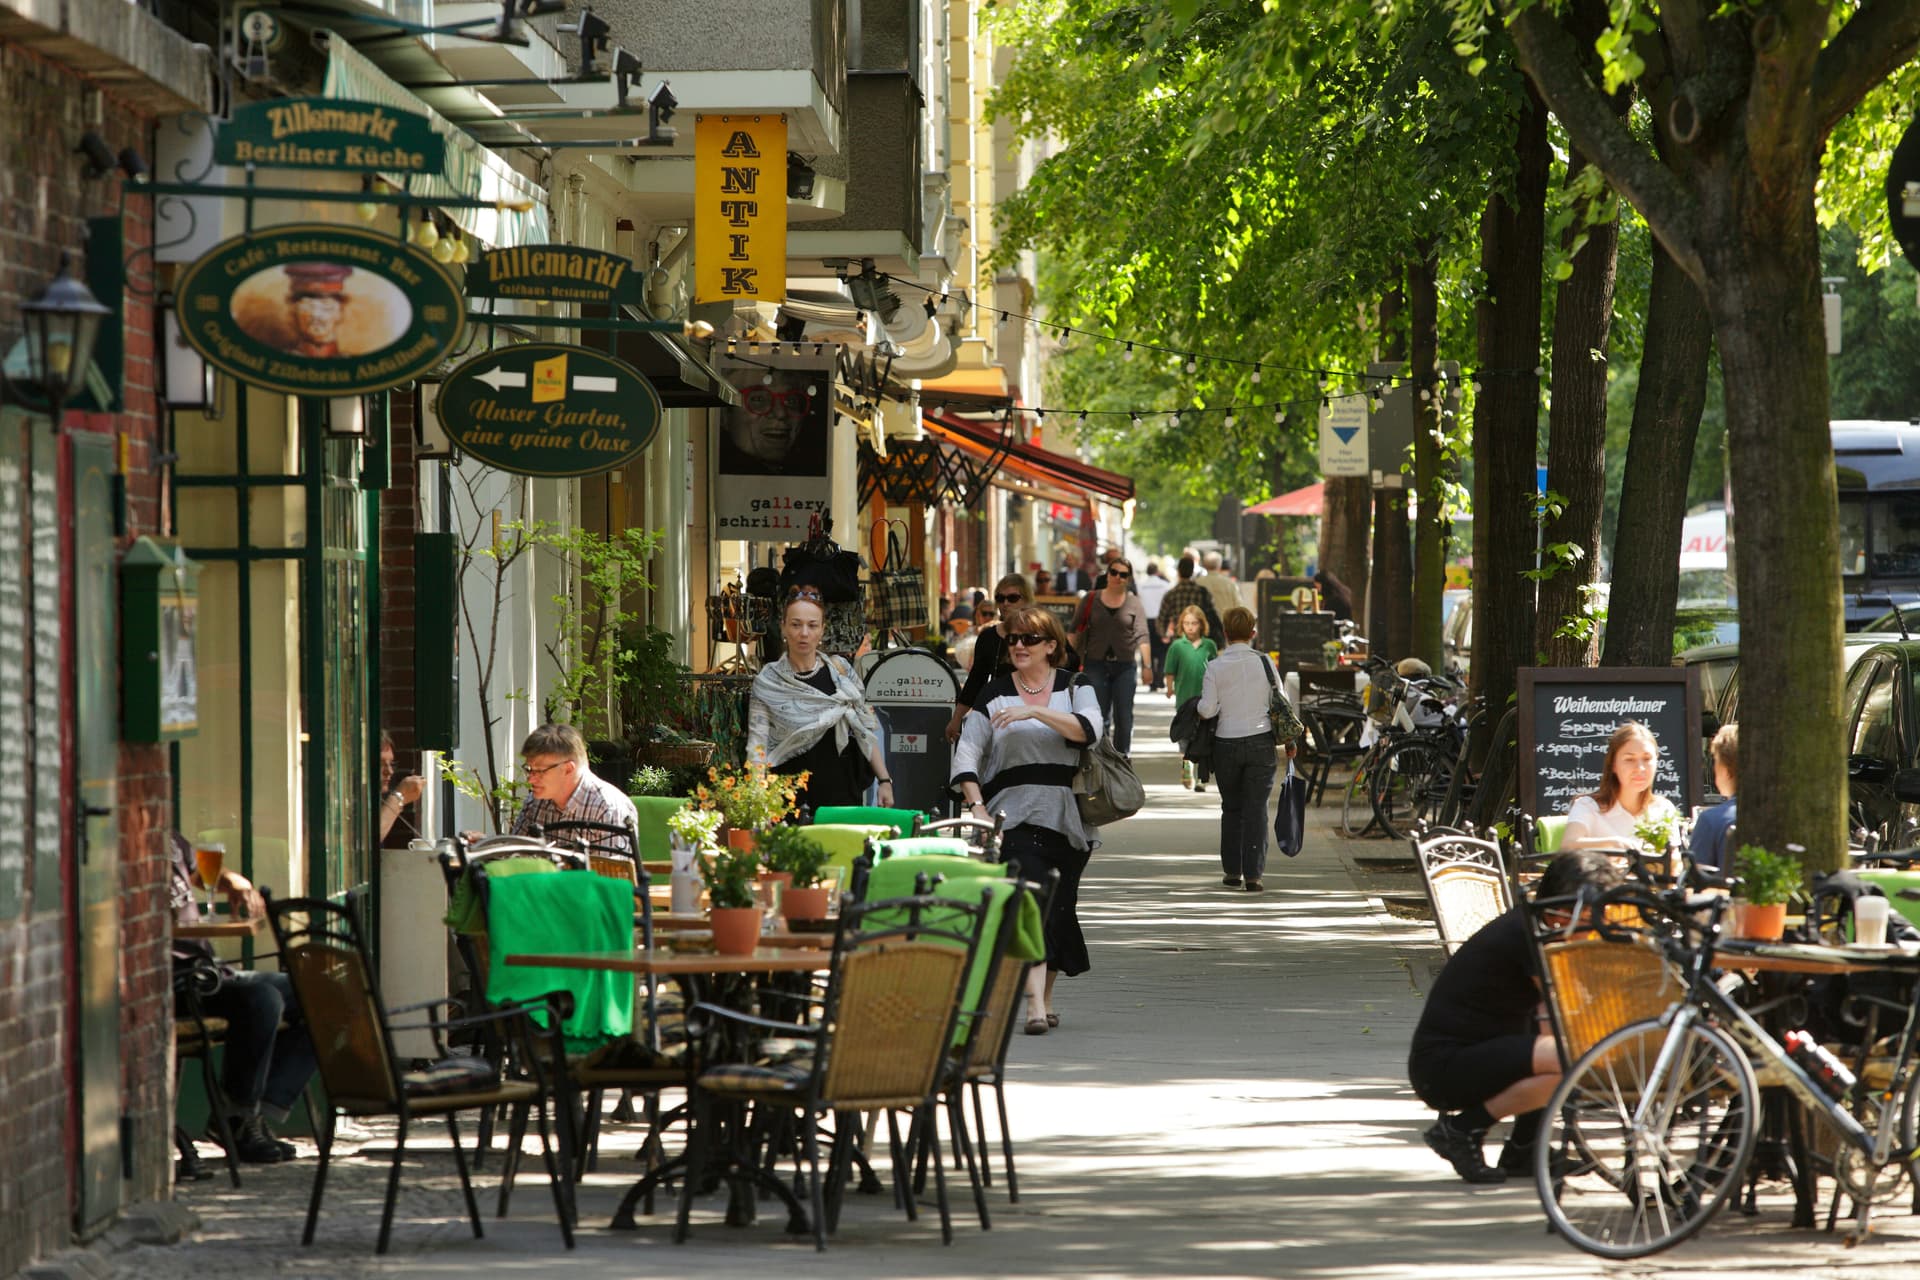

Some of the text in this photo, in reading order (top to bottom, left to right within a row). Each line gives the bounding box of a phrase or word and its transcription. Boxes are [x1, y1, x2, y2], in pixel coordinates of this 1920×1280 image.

[266, 102, 398, 142] Zillemarkt
[235, 140, 424, 168] Berliner Küche
[720, 131, 761, 294] ANTIK
[485, 247, 627, 289] Zillemarkt
[202, 320, 266, 371] Original
[469, 399, 627, 432] Unser Garten,
[462, 425, 631, 453] eine grüne Oase
[750, 497, 825, 512] gallery
[1685, 536, 1728, 552] AV
[1553, 696, 1667, 715] Weihenstephaner
